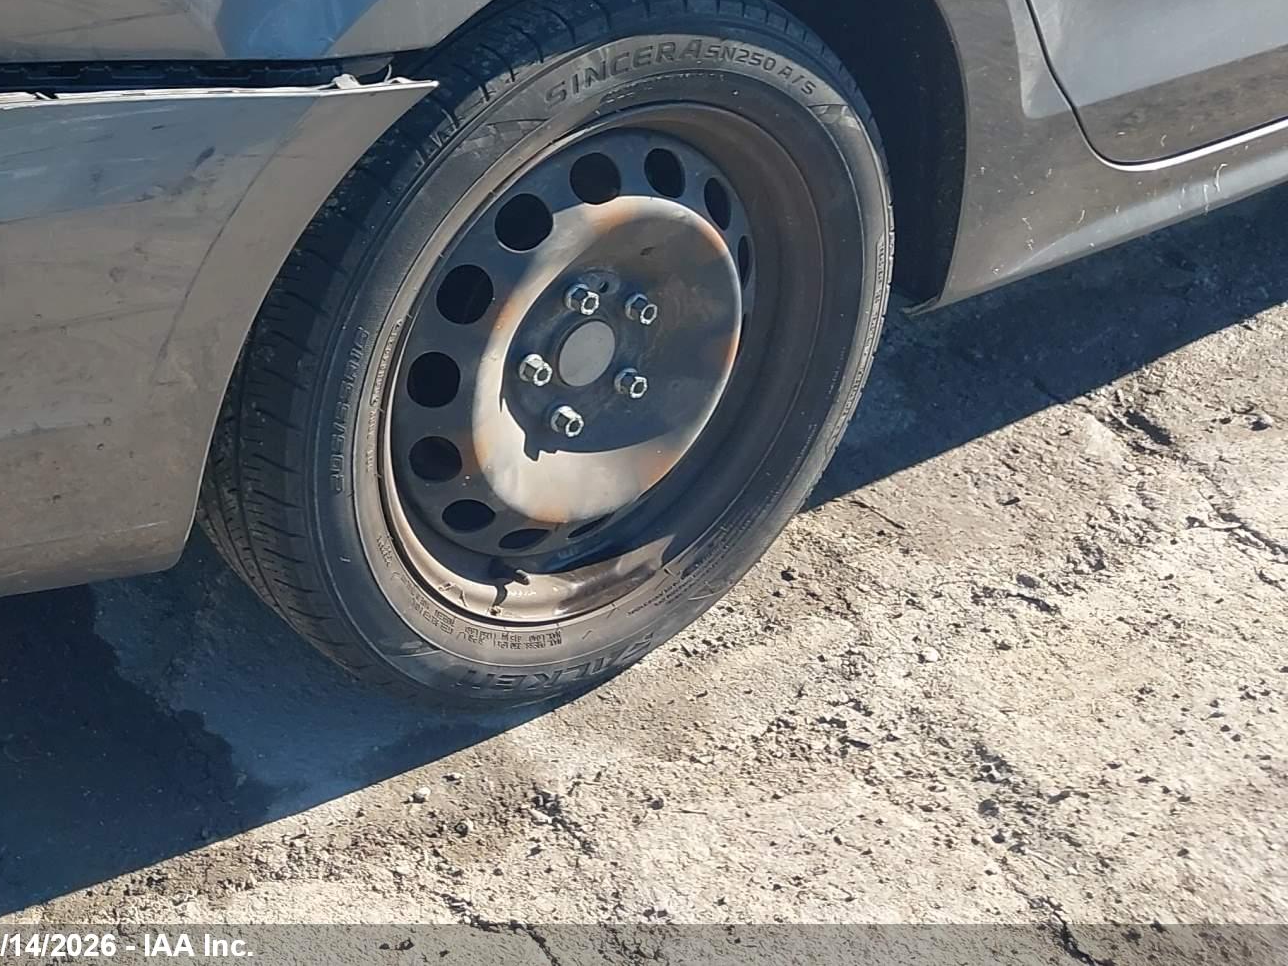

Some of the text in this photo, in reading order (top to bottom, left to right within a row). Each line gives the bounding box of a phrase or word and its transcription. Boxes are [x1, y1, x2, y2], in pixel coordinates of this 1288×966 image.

[544, 39, 703, 107] SINCERA
[703, 44, 777, 72] SN250
[777, 66, 817, 96] A/S
